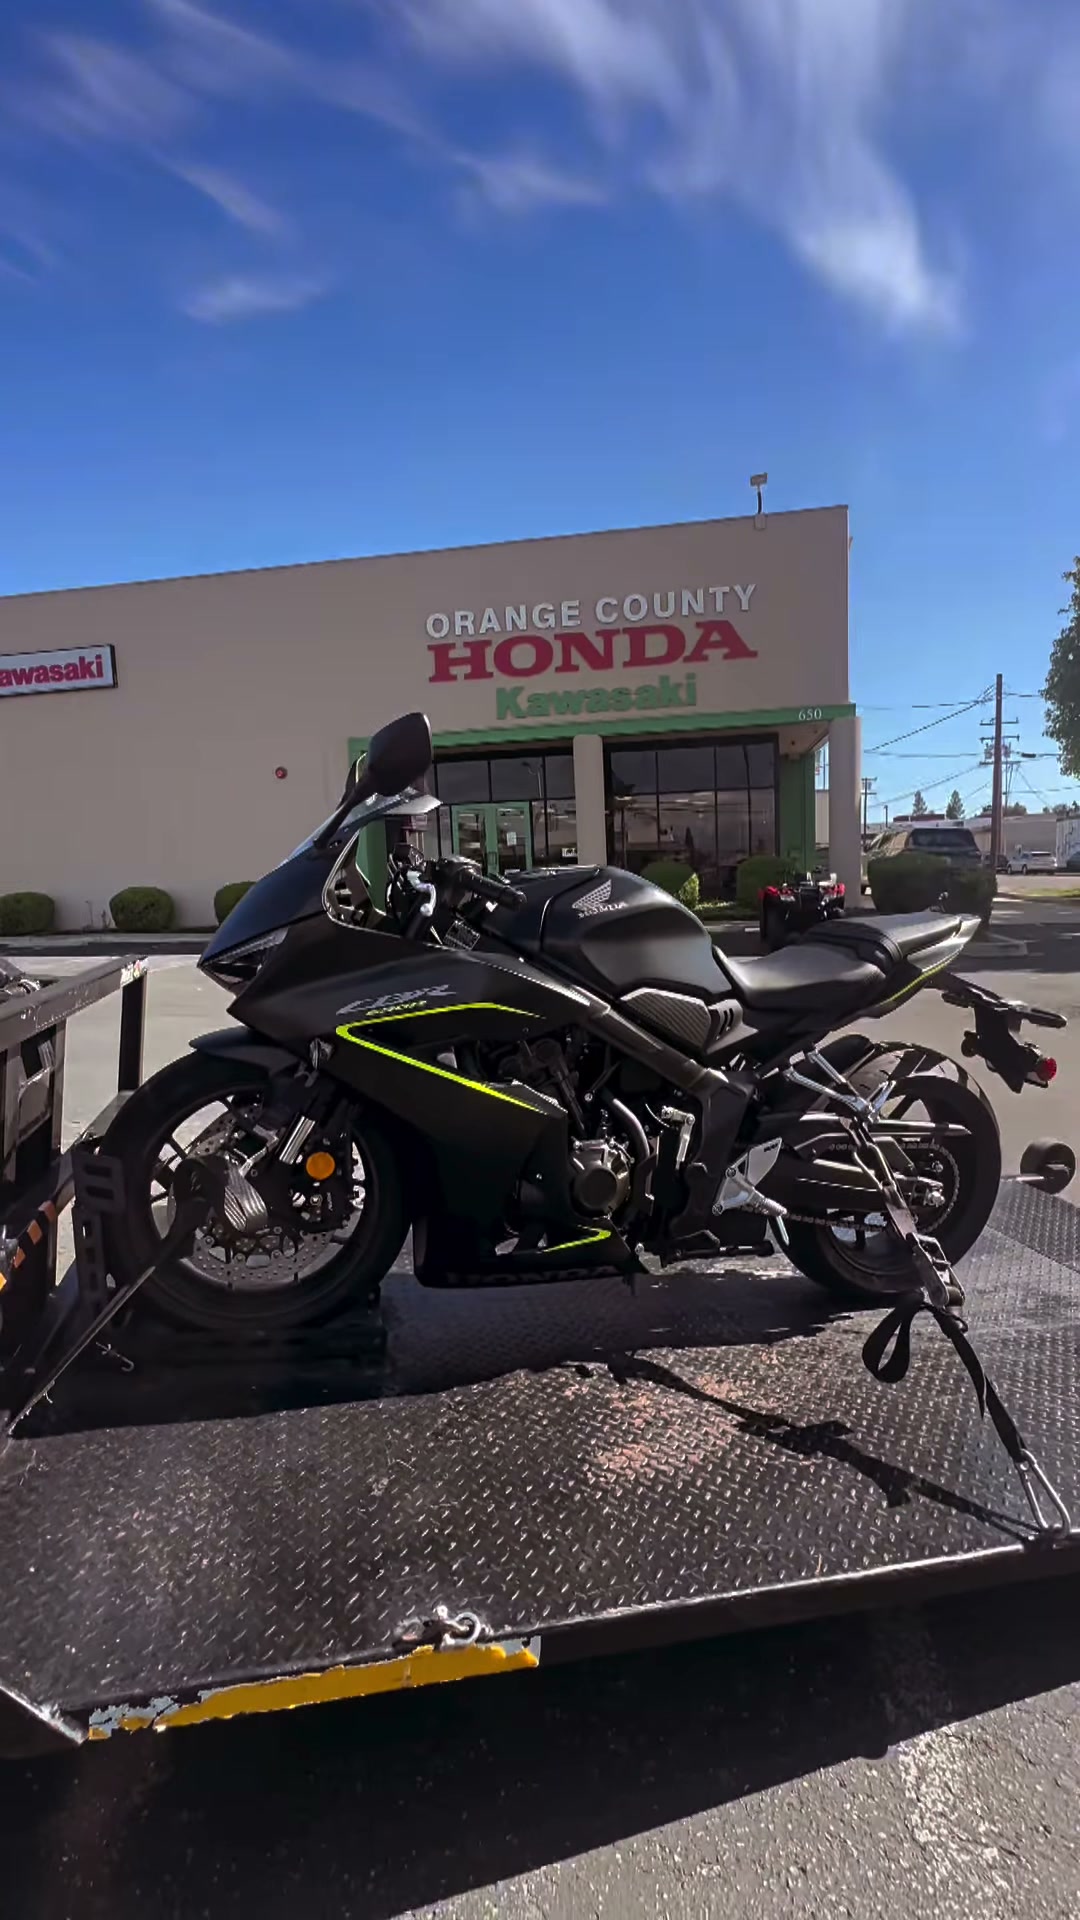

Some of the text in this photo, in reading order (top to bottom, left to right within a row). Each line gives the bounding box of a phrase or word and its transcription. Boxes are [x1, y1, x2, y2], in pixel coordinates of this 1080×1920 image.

[426, 583, 756, 638] ORANGE COUNTY
[427, 620, 758, 683] HONDA
[496, 673, 697, 720] Kawasaki
[799, 707, 822, 720] 650
